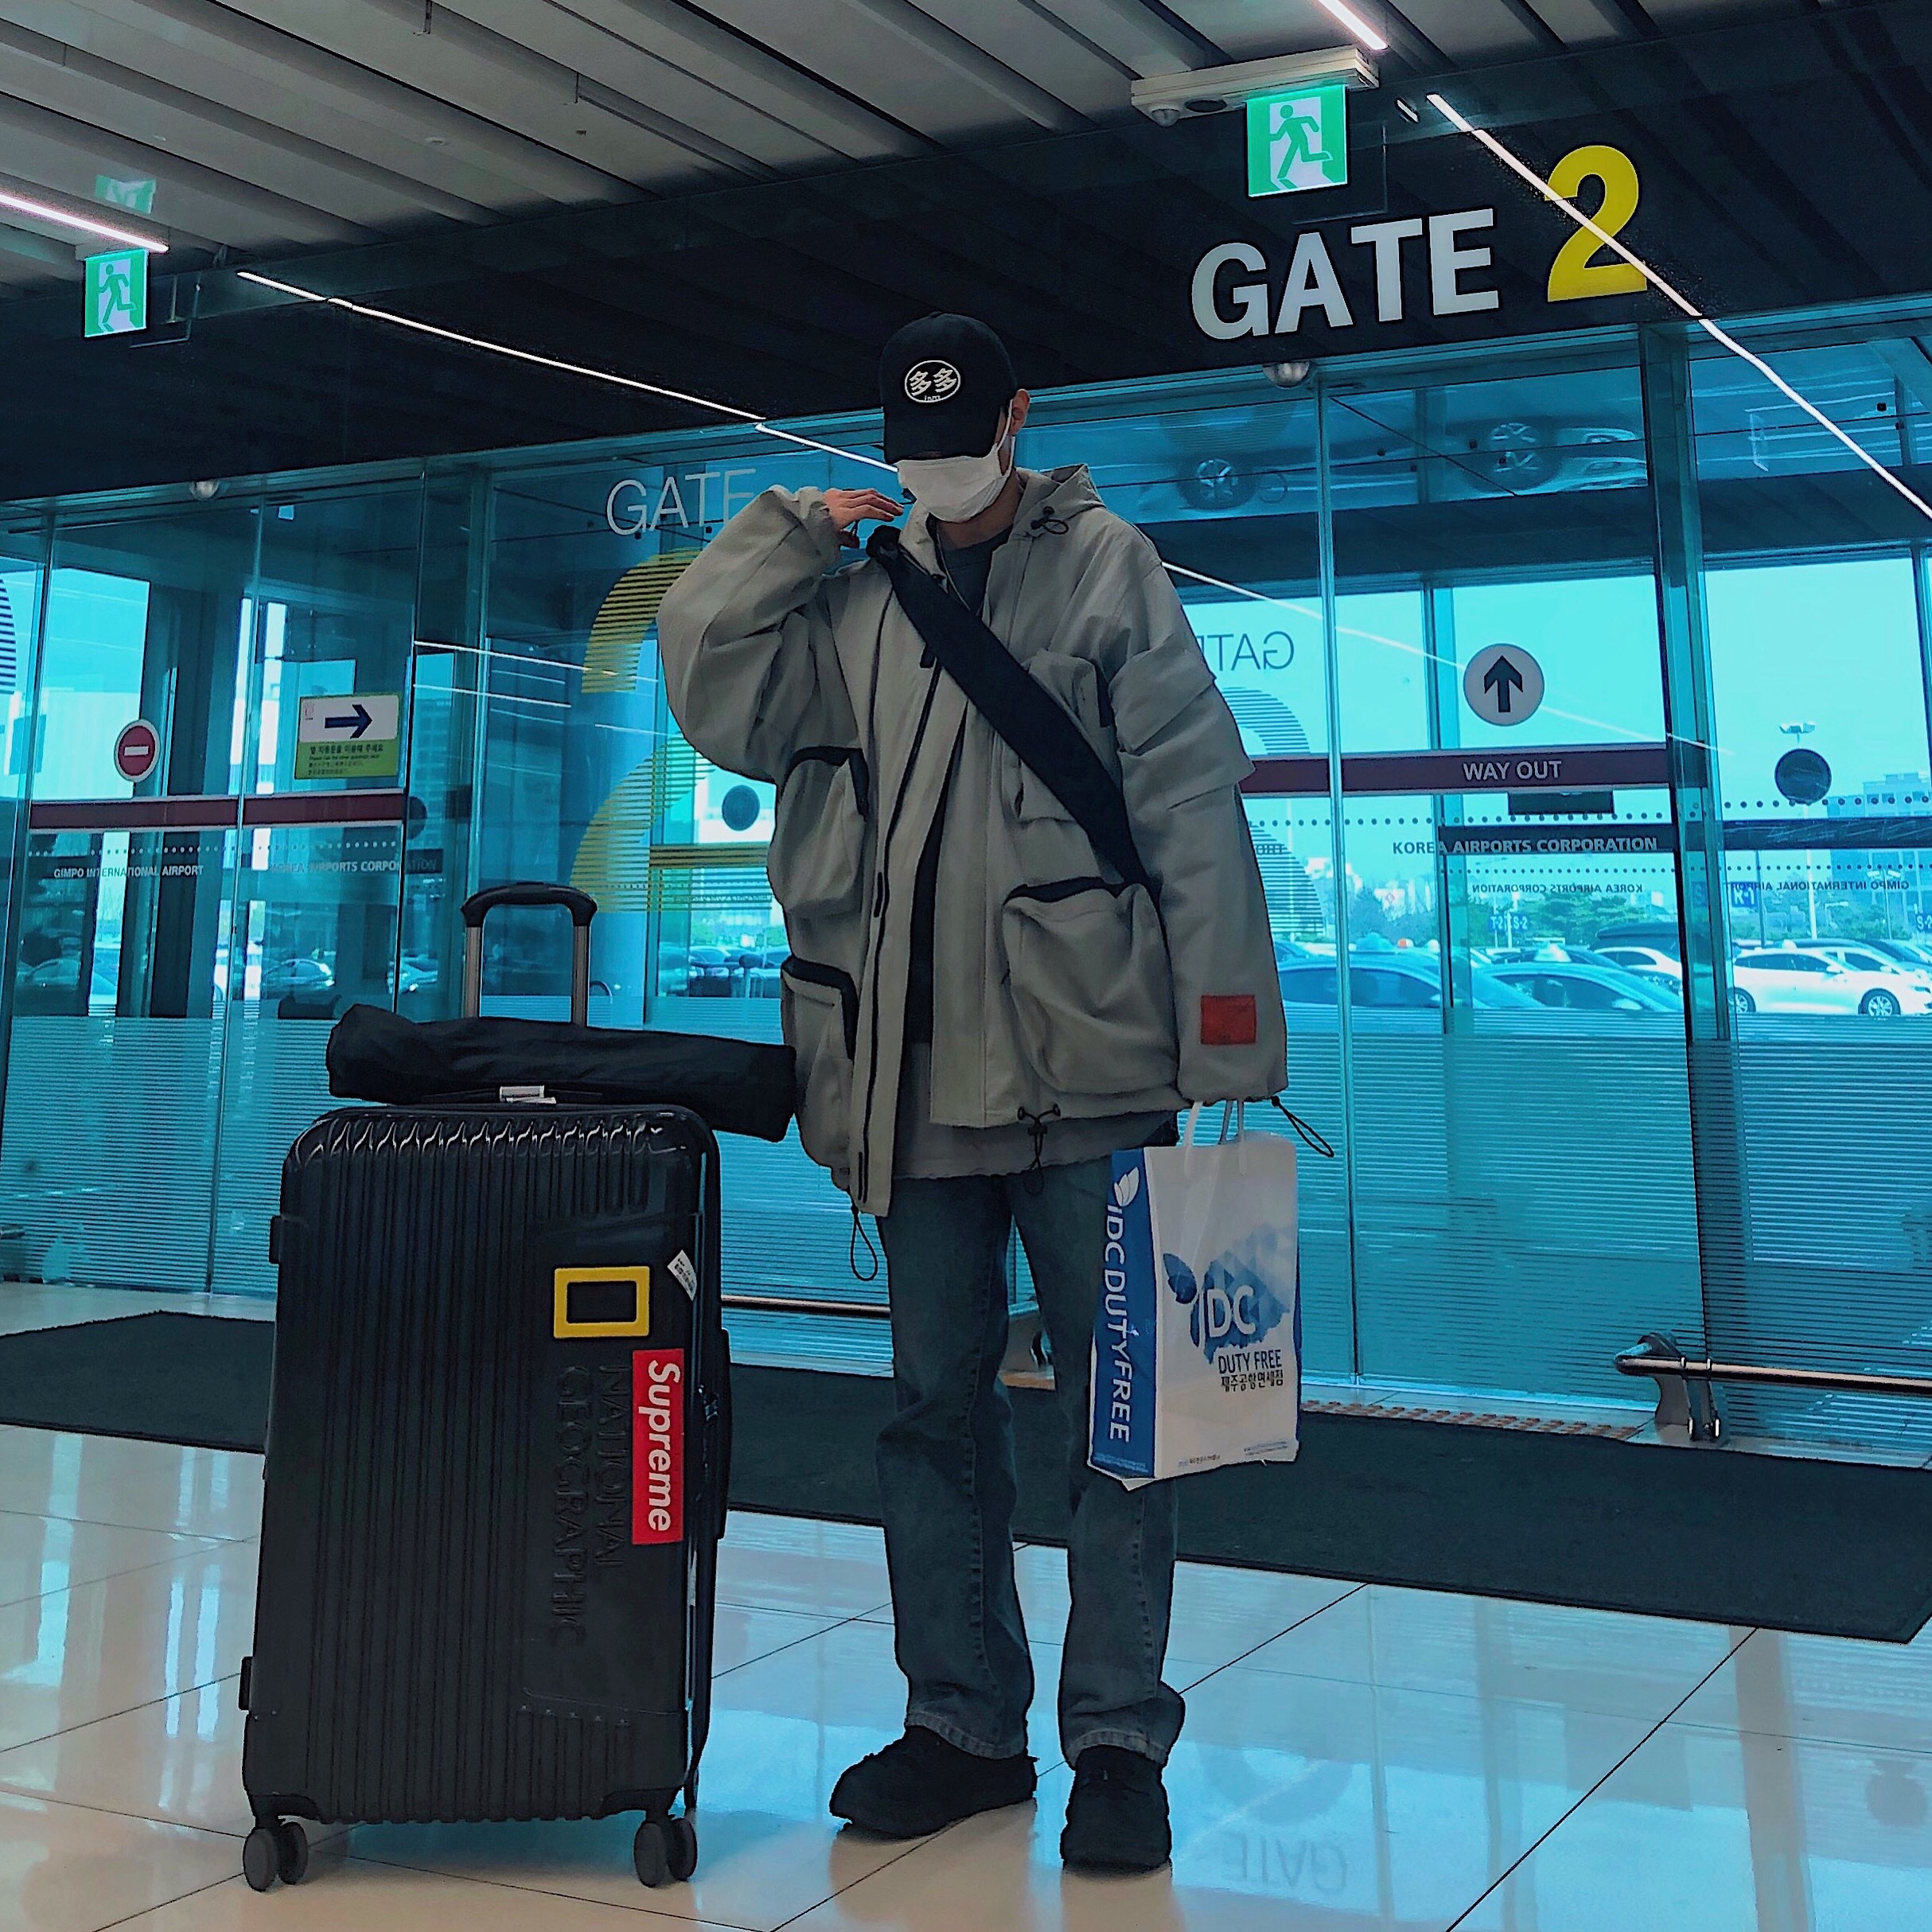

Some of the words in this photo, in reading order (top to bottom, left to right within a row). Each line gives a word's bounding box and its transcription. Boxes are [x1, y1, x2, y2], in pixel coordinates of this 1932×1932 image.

[1193, 208, 1500, 340] GATE
[1544, 144, 1648, 302] 2
[909, 368, 957, 396] 多多
[1462, 762, 1509, 781] WAY
[1516, 760, 1562, 780] OUT
[1393, 840, 1448, 855] KOREA
[1452, 839, 1533, 854] AIRPORTS
[1537, 836, 1659, 853] CORPORATION
[53, 868, 84, 878] GIMPO
[86, 867, 160, 877] INTERNATIONAL
[162, 865, 204, 876] AIRPORT
[1513, 916, 1529, 930] S-2
[1104, 1204, 1125, 1265] IDC
[1198, 1284, 1256, 1350] IDC
[1218, 1352, 1250, 1374] DUTY
[1254, 1349, 1283, 1370] FREE
[637, 1359, 681, 1532] Supreme
